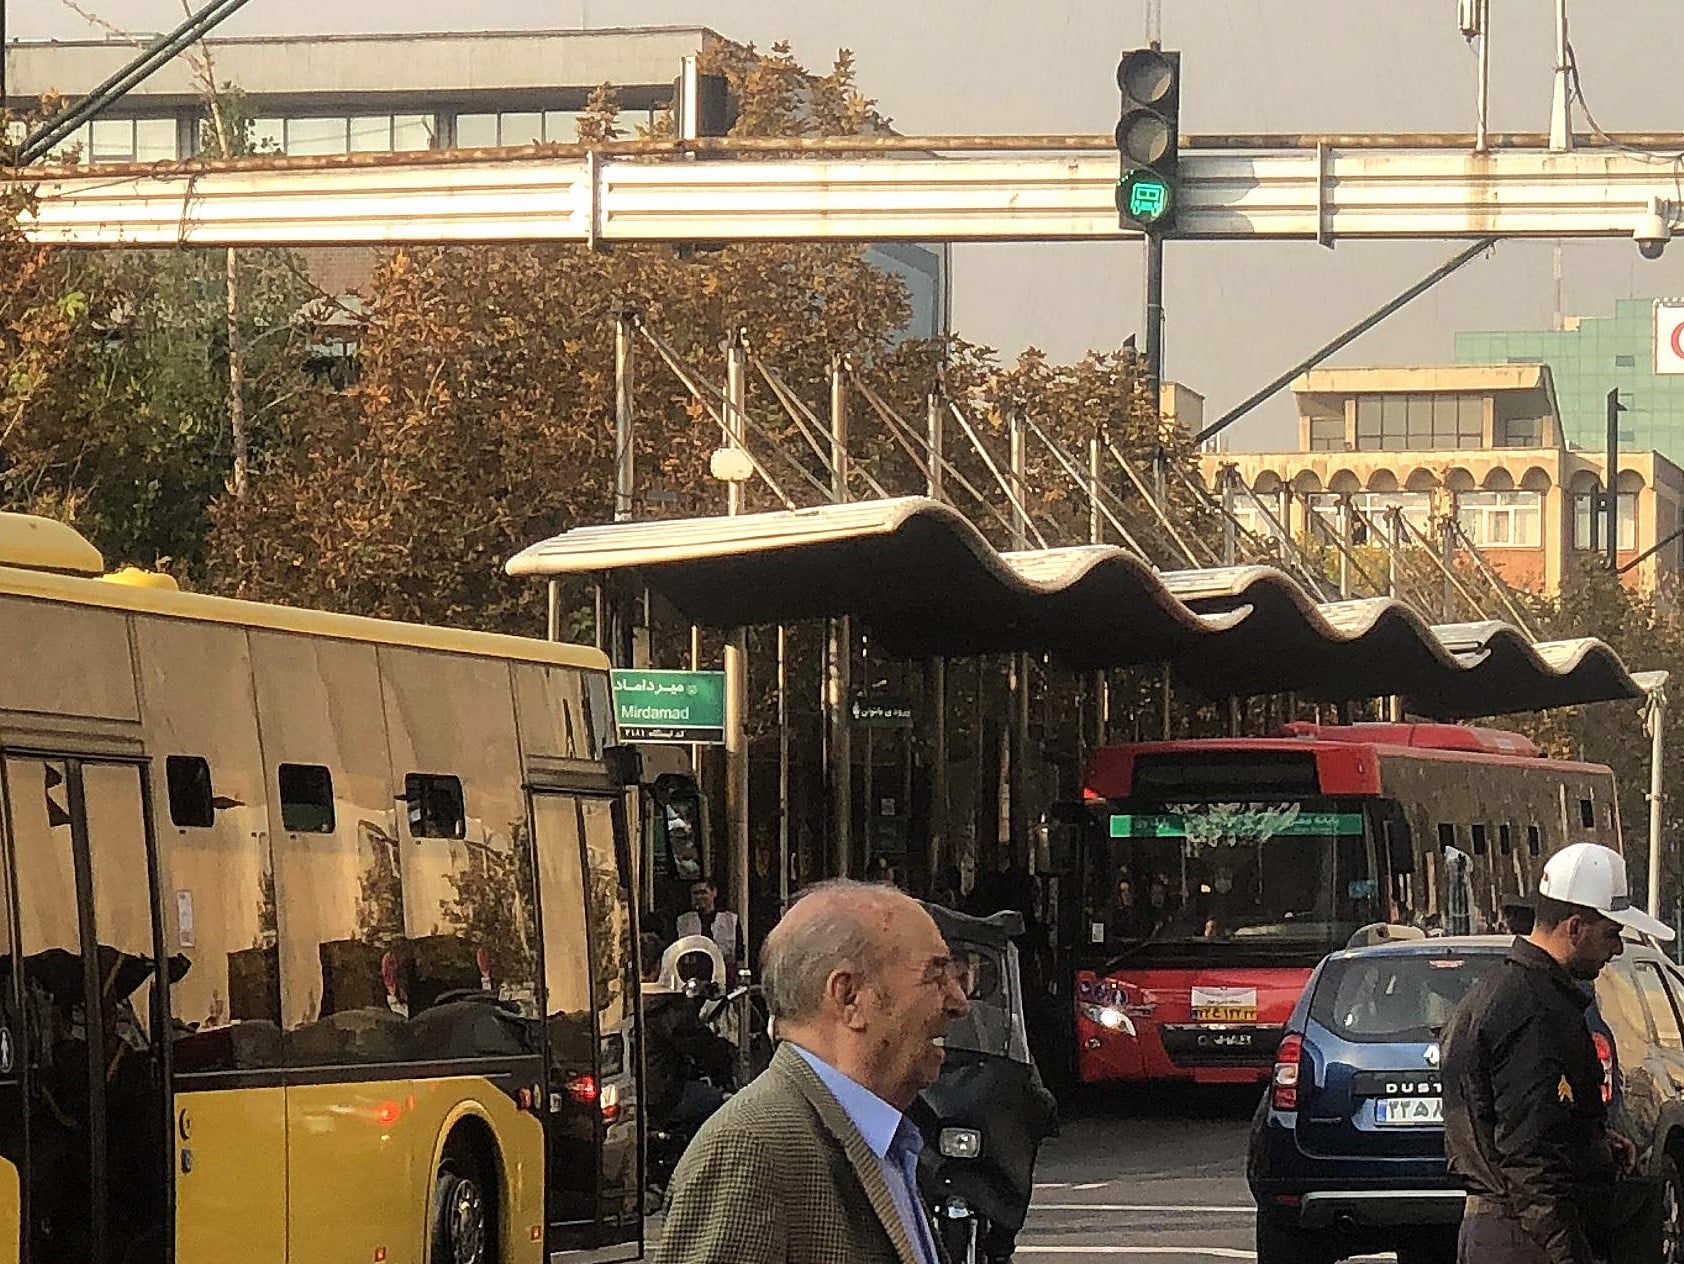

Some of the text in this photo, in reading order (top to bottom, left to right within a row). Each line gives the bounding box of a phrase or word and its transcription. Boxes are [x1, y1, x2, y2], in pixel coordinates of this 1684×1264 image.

[614, 679, 684, 695] میرداماد
[621, 705, 690, 720] Mirdamad
[1386, 1082, 1442, 1094] DUST
